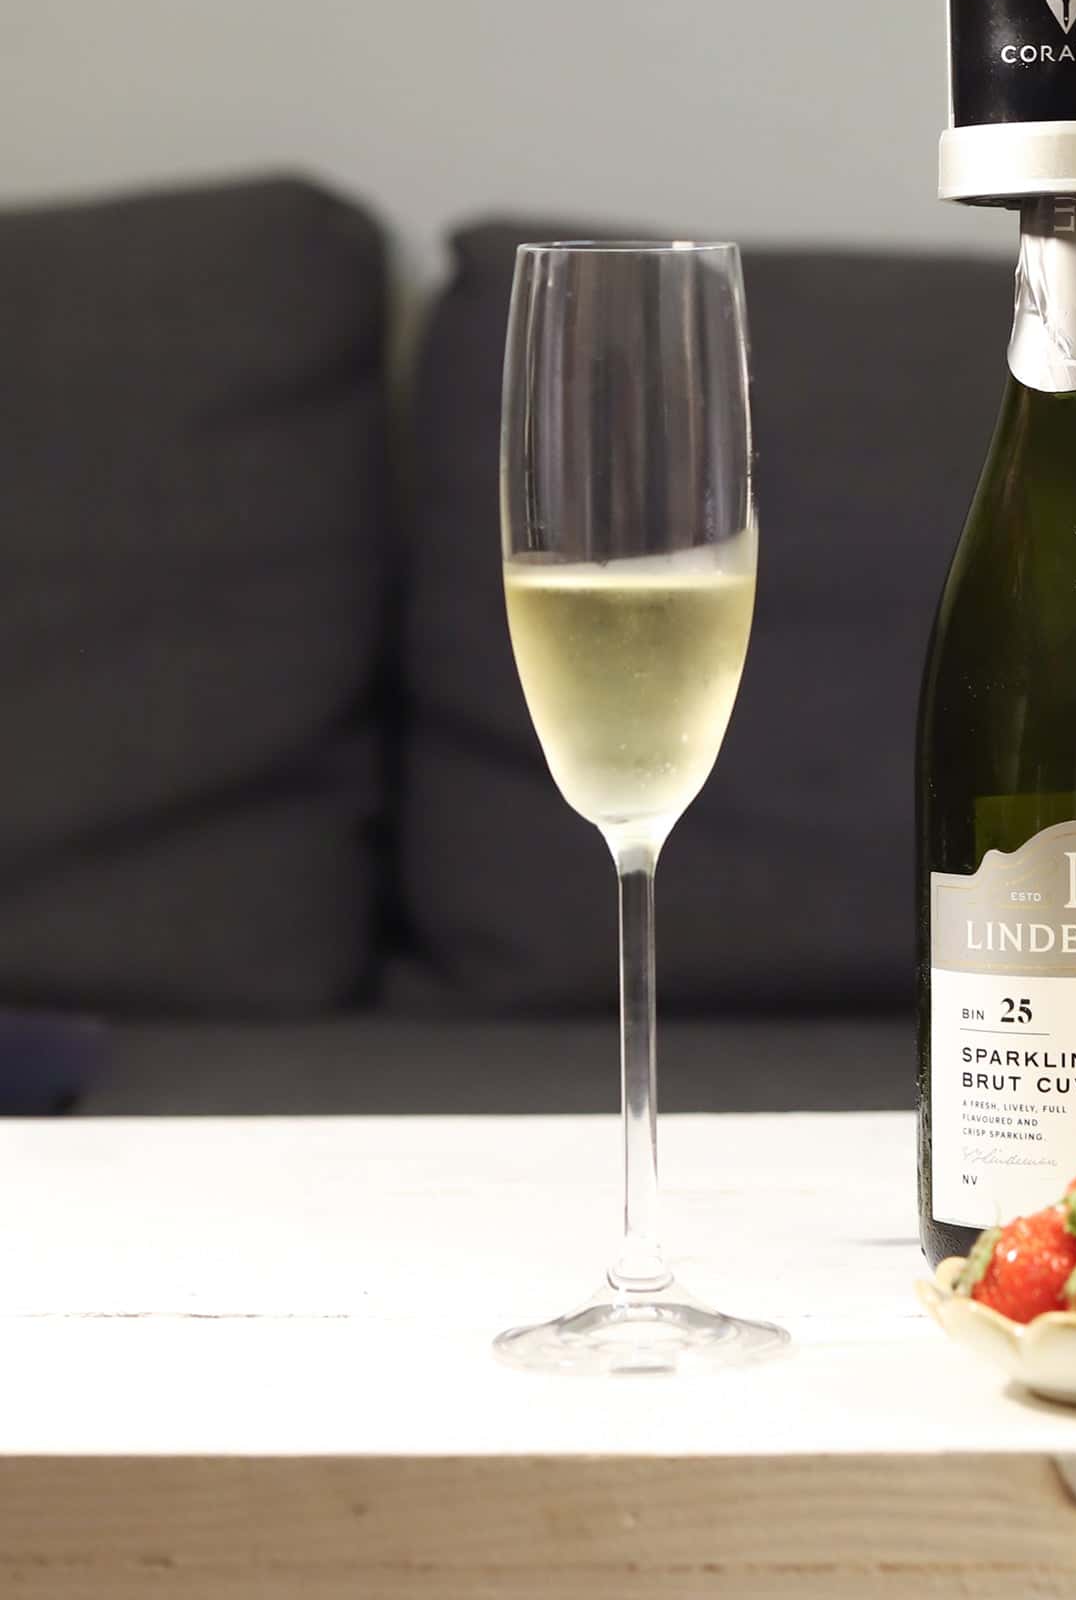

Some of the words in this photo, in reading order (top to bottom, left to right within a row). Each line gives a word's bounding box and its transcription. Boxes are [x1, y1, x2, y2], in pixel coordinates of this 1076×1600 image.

[1010, 891, 1041, 902] ESTD
[962, 1008, 985, 1020] BIN
[1000, 997, 1033, 1024] 25
[962, 1072, 1022, 1092] BRUT
[1003, 1103, 1039, 1114] LIVELY,
[1042, 1105, 1068, 1113] FULL
[962, 1113, 1013, 1125] FLAVOURED
[1017, 1118, 1039, 1127] AND
[962, 1127, 986, 1137] CRISP
[962, 1174, 978, 1185] NV
